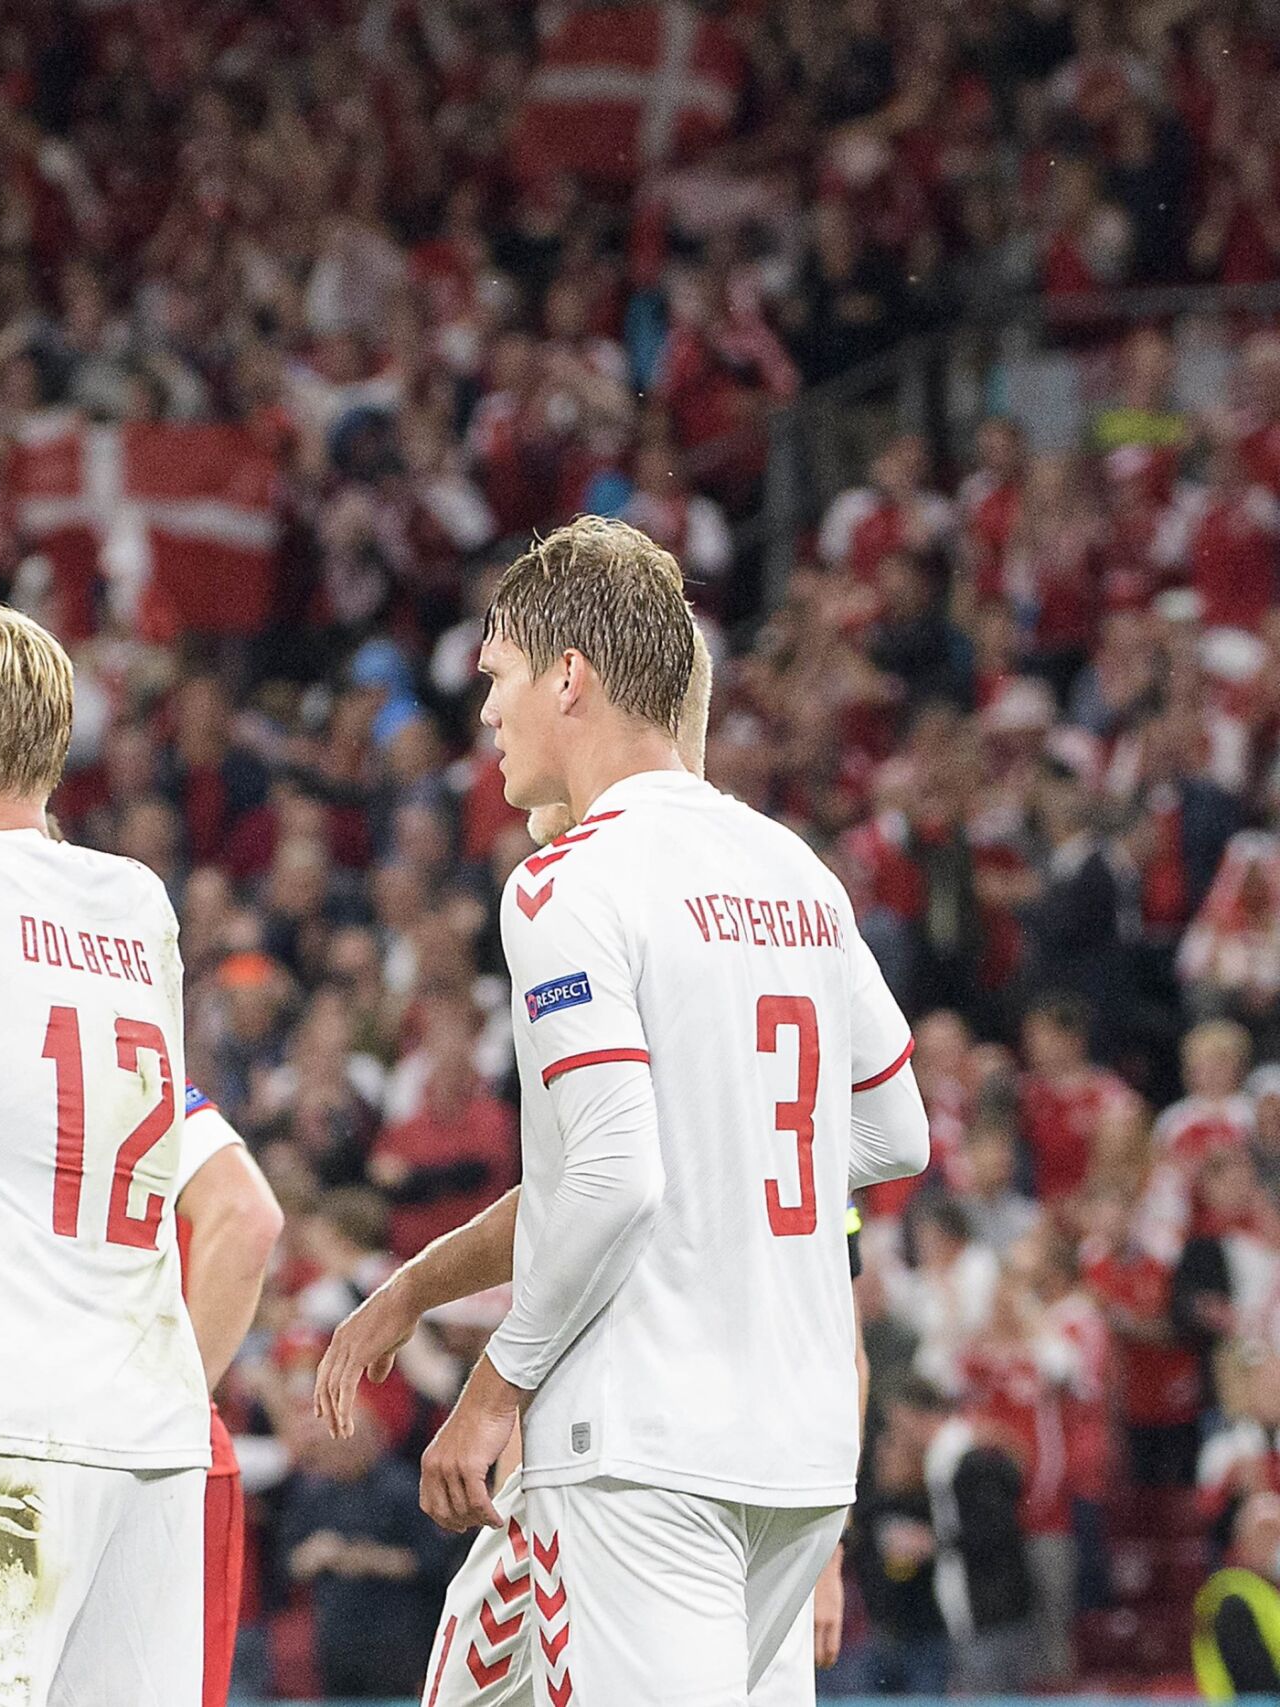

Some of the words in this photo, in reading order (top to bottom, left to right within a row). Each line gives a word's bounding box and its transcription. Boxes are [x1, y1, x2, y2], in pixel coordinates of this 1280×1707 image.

[20, 915, 153, 986] DOLBERG
[684, 894, 845, 953] VESTERGAAR
[535, 980, 588, 1009] RESPECT
[42, 1006, 176, 1251] 12
[756, 994, 821, 1237] 3
